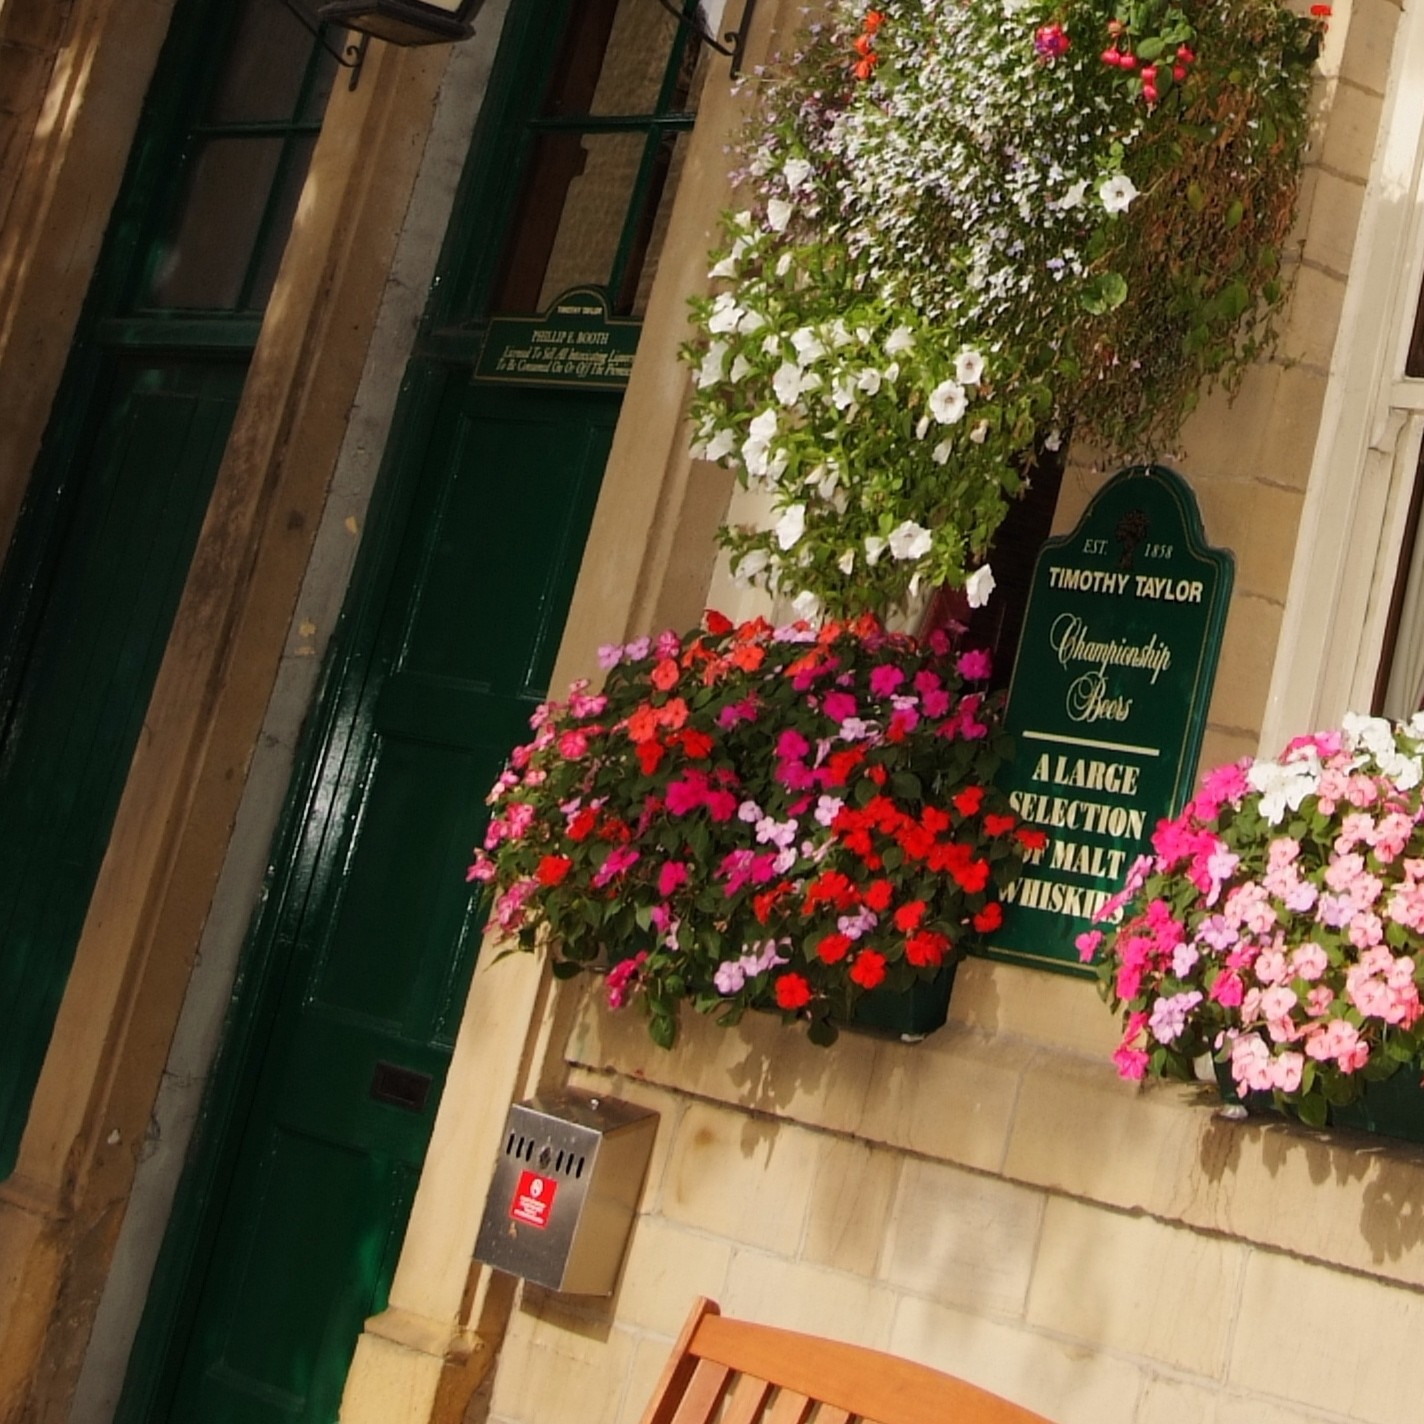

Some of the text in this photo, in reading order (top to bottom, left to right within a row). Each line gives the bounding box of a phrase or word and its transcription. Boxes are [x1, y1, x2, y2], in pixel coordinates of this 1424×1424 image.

[576, 332, 610, 345] BOOTH
[1082, 539, 1174, 559] EST. 1858
[1050, 567, 1204, 603] TIMOTHY TAYLOR
[1050, 612, 1172, 685] Championship
[1066, 671, 1133, 723] Beers
[1032, 753, 1141, 796] A LARGE
[1009, 790, 1147, 841] SELECTION
[1050, 840, 1126, 880] MALT
